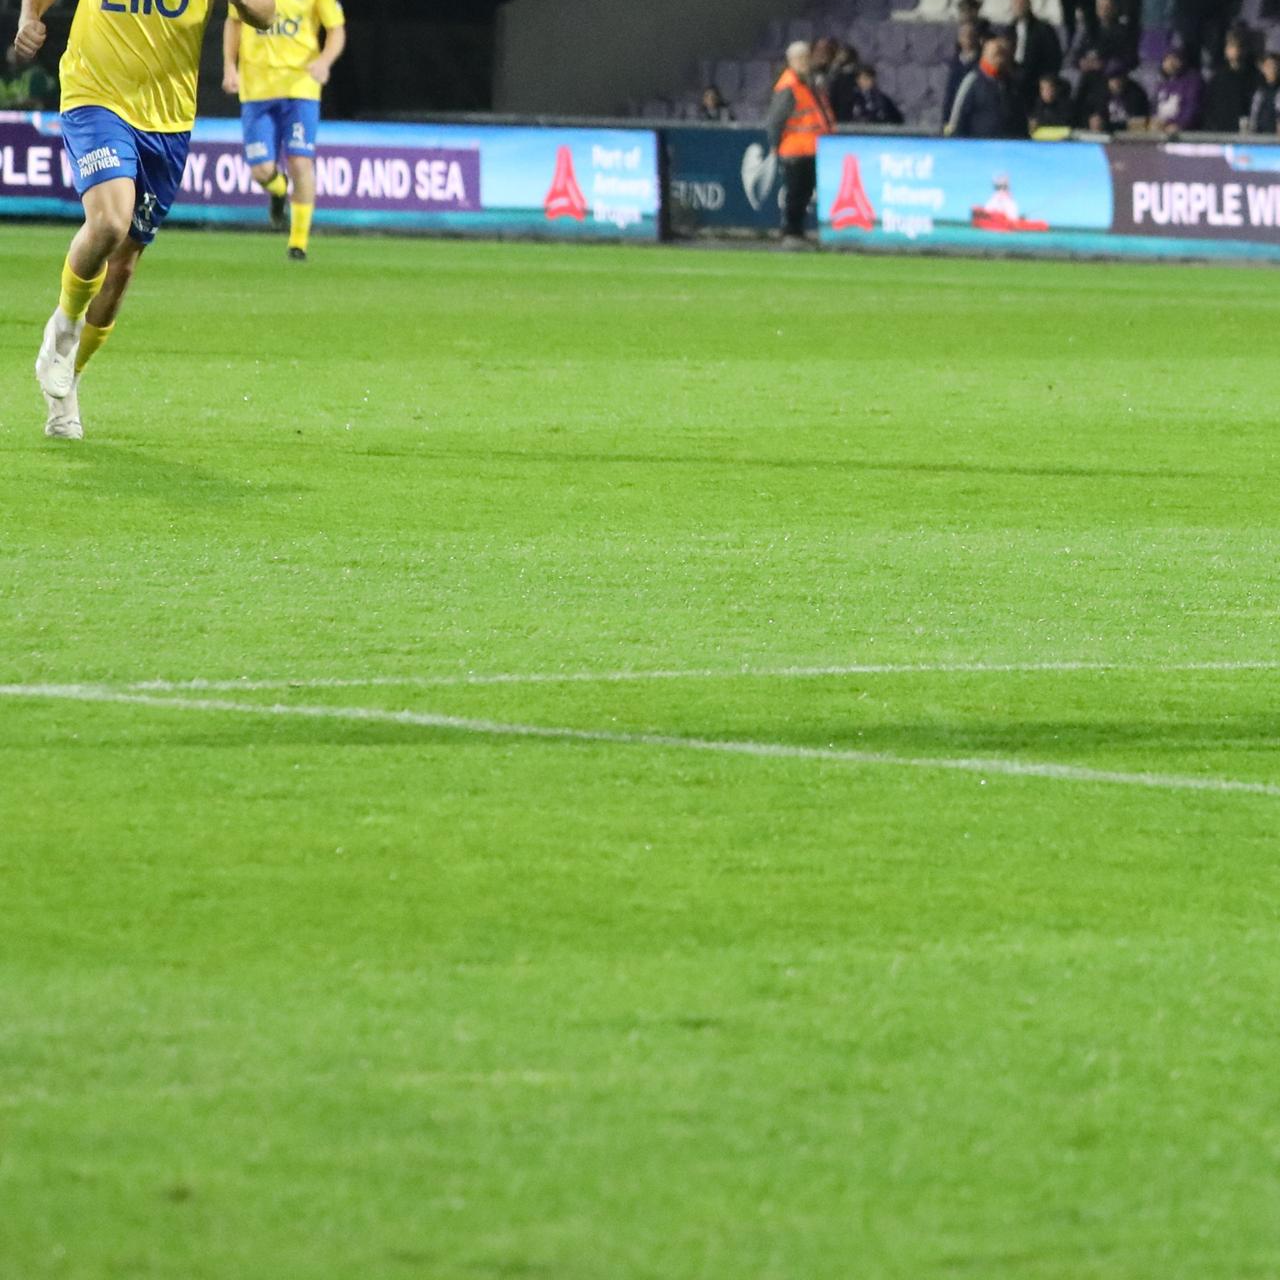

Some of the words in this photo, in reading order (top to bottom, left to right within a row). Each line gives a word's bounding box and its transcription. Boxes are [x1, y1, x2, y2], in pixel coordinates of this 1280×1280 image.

[356, 158, 411, 199] AND
[415, 160, 466, 201] SEA
[1132, 181, 1243, 226] PURPLE
